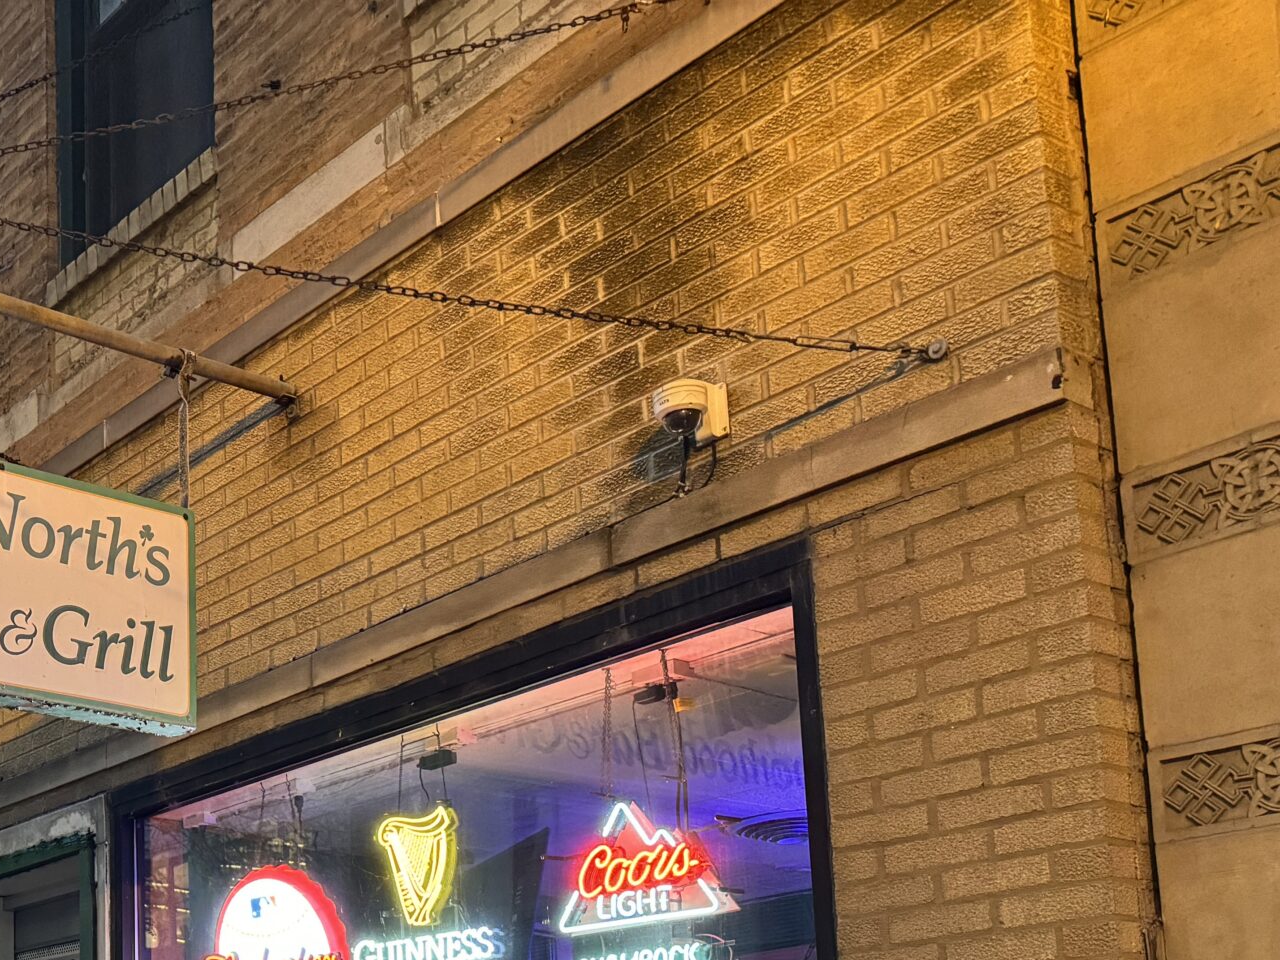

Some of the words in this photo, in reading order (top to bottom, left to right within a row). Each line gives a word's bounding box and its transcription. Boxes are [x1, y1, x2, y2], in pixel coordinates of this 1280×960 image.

[41, 604, 176, 685] Grill
[578, 843, 700, 899] Coors
[596, 885, 672, 920] LIGHT
